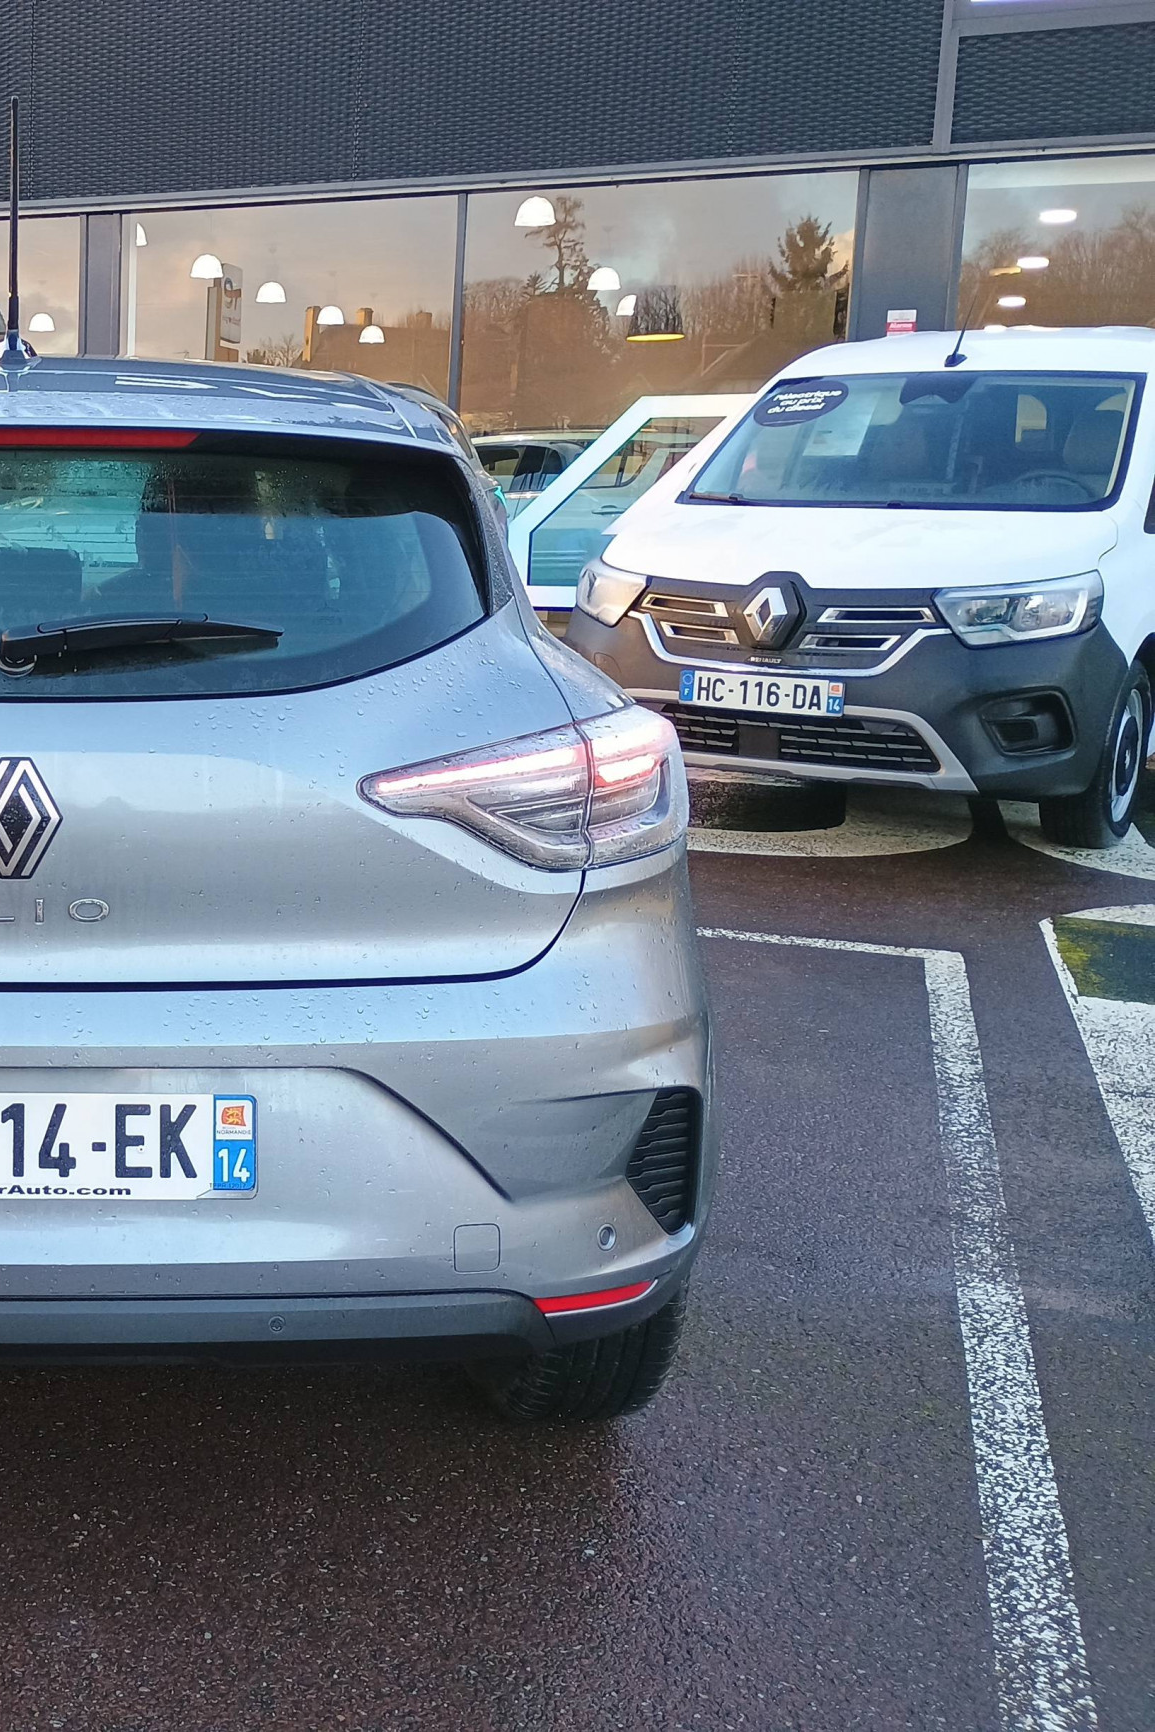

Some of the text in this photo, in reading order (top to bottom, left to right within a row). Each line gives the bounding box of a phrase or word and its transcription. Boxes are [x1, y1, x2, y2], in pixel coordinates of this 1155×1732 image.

[684, 688, 690, 696] F
[696, 676, 822, 711] HC-116-DA
[828, 698, 841, 712] 14
[218, 1148, 250, 1182] 14
